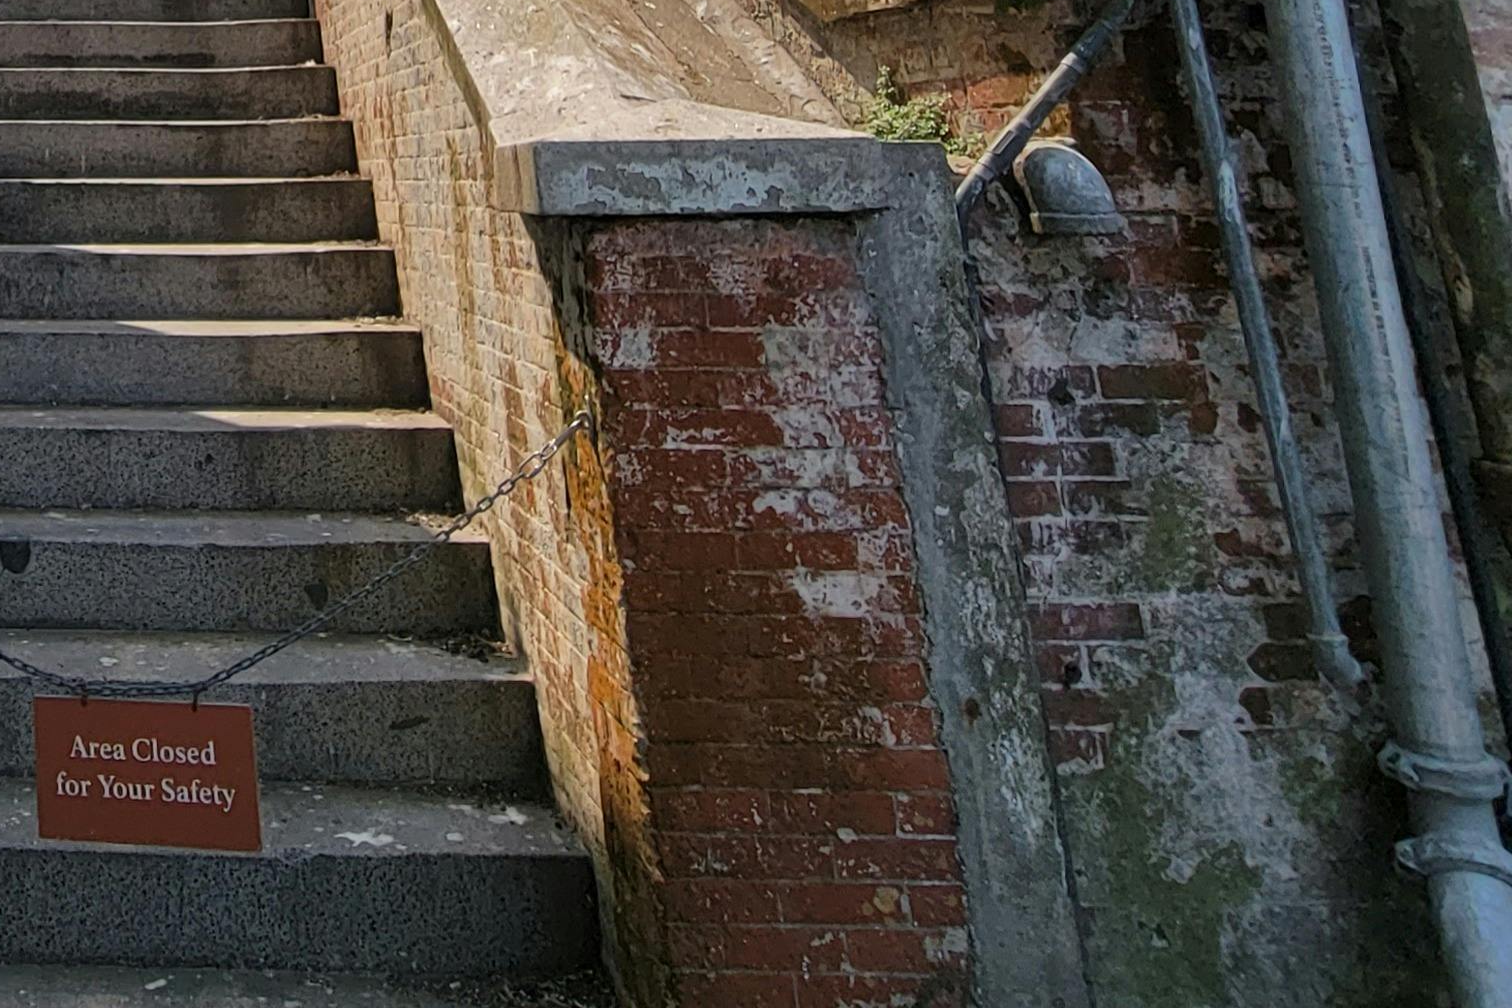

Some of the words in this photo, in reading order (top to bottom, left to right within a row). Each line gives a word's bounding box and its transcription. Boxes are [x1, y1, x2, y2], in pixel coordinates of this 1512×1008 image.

[70, 735, 126, 761] Area
[132, 738, 216, 765] Closed
[56, 771, 91, 796] for
[96, 774, 155, 801] Your
[161, 778, 236, 812] Safety
